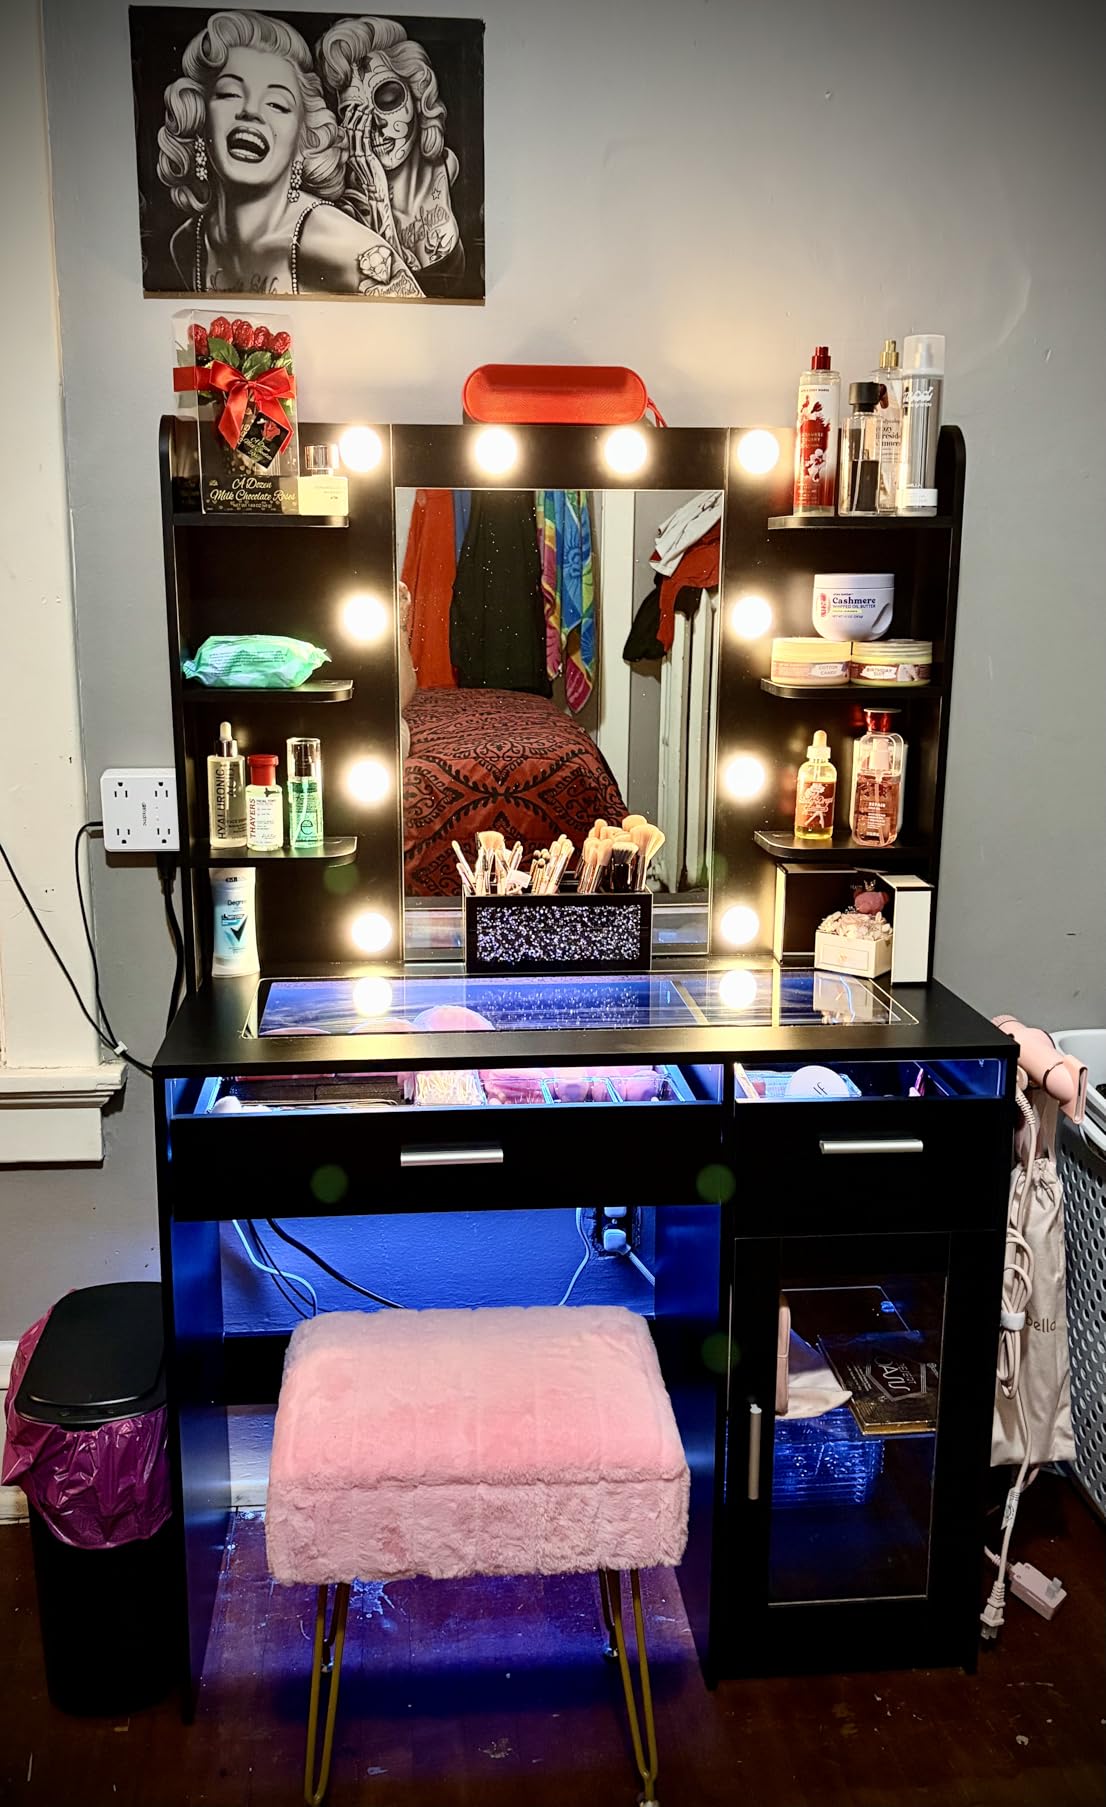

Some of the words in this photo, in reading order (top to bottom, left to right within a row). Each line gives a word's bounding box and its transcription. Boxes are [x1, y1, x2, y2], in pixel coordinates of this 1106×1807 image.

[231, 478, 245, 489] A
[246, 477, 272, 489] Dozen
[210, 489, 234, 501] Milk
[235, 489, 272, 501] Chocolate
[272, 489, 296, 501] Roses
[832, 596, 876, 604] Cashmere
[215, 768, 227, 839] HYALURONIC
